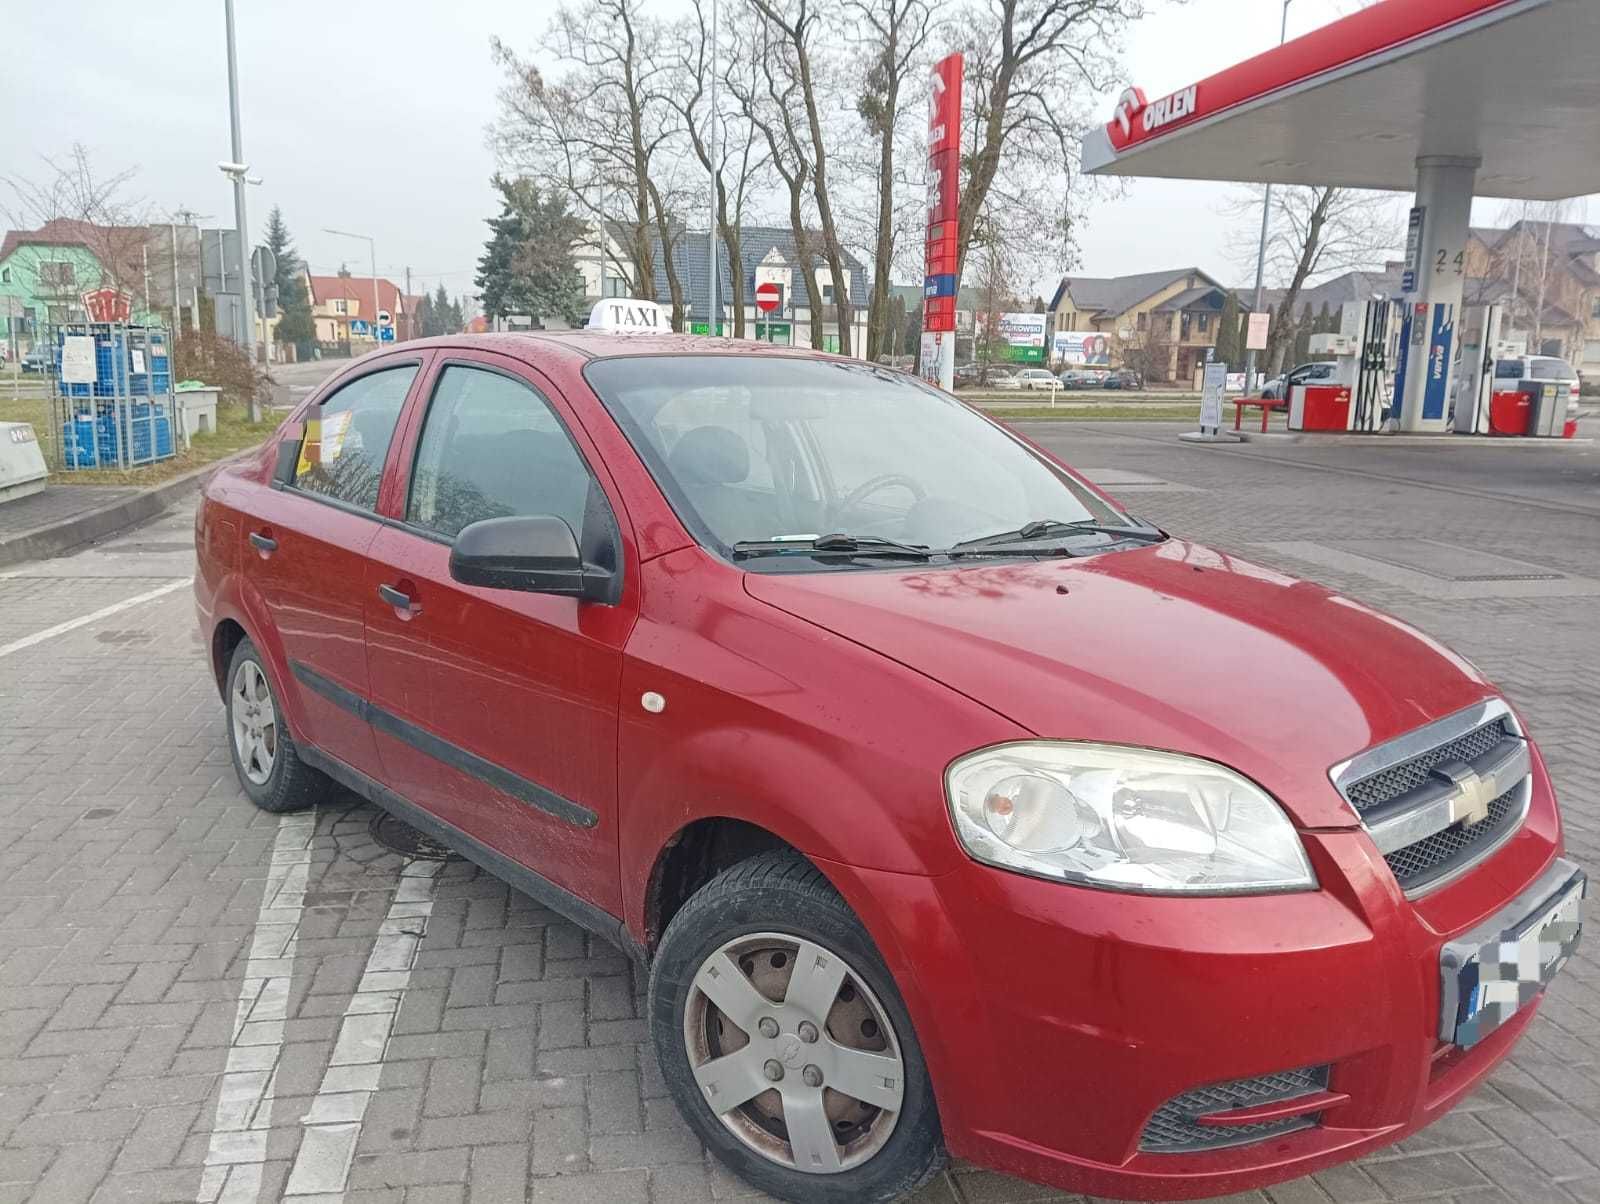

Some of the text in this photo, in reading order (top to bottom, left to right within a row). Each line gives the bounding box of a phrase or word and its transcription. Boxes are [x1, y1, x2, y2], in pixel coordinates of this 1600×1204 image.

[1143, 85, 1198, 132] ORLEN
[1436, 249, 1448, 265] 2
[1453, 250, 1465, 268] 4
[609, 305, 659, 328] TAXI
